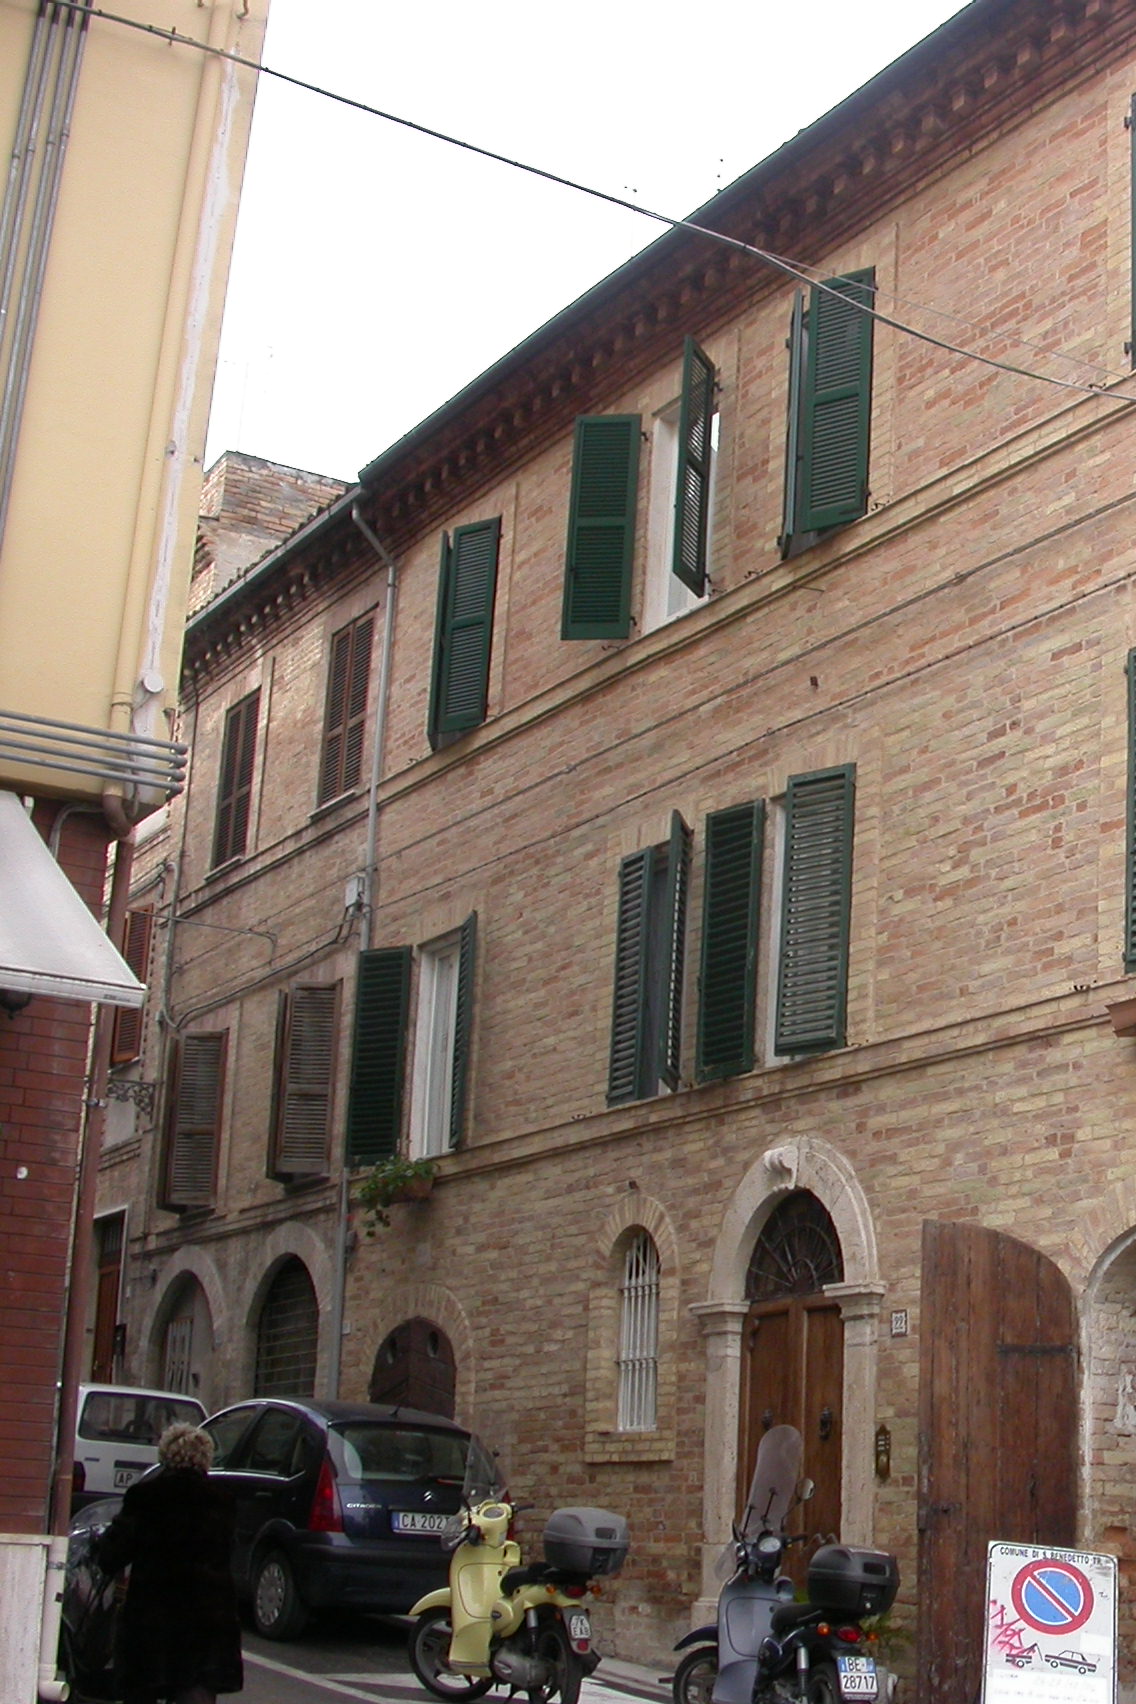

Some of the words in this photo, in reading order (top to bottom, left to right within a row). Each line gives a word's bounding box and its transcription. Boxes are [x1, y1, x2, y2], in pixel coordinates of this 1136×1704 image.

[401, 1513, 417, 1529] CA
[1000, 1546, 1028, 1558] COMUNE
[1032, 1550, 1039, 1558] DI
[848, 1657, 861, 1672] BE
[843, 1675, 875, 1690] 28717
